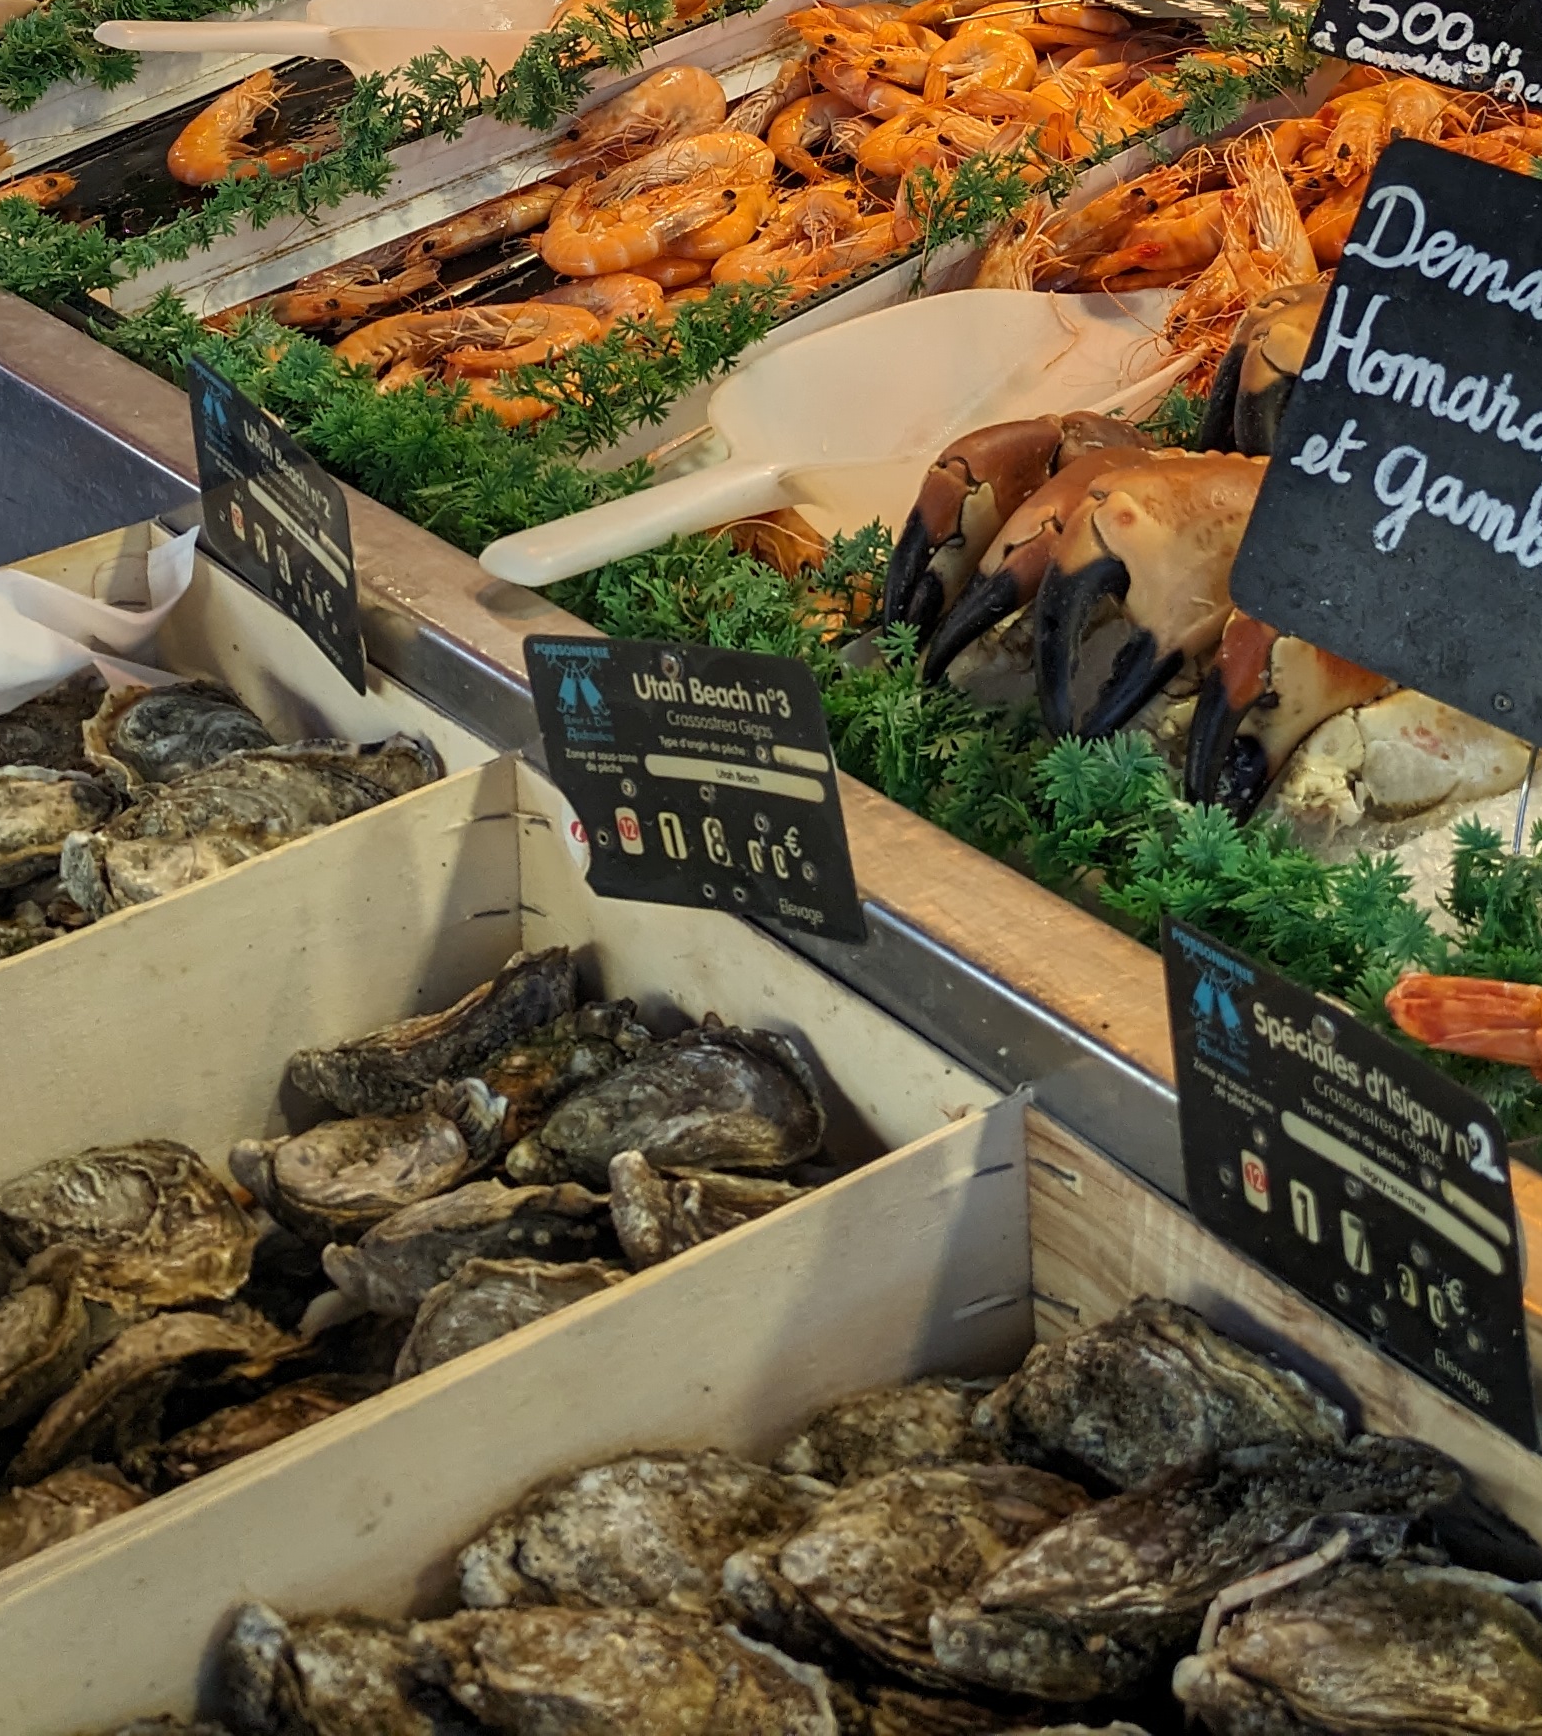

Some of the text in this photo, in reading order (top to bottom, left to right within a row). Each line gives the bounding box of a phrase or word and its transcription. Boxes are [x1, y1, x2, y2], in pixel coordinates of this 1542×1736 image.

[1290, 417, 1367, 486] et
[632, 672, 793, 719] Utah Beach n°3
[666, 709, 774, 741] Crassostrea Gigas
[565, 748, 638, 765] Zone sous-zone
[658, 735, 678, 749] Type
[585, 761, 624, 775] de pêche
[715, 768, 761, 785] Utah Beach
[621, 817, 637, 840] 12
[783, 826, 802, 858] €
[1191, 1056, 1216, 1081] Zone
[1216, 1069, 1228, 1085] et
[1252, 1000, 1361, 1090] Spéciales
[1364, 1070, 1451, 1153] d'Isigny
[1228, 1091, 1256, 1116] pêche
[1301, 1098, 1324, 1120] Type
[1362, 1132, 1375, 1151] de
[1312, 1075, 1443, 1172] Crassostrea Gigas
